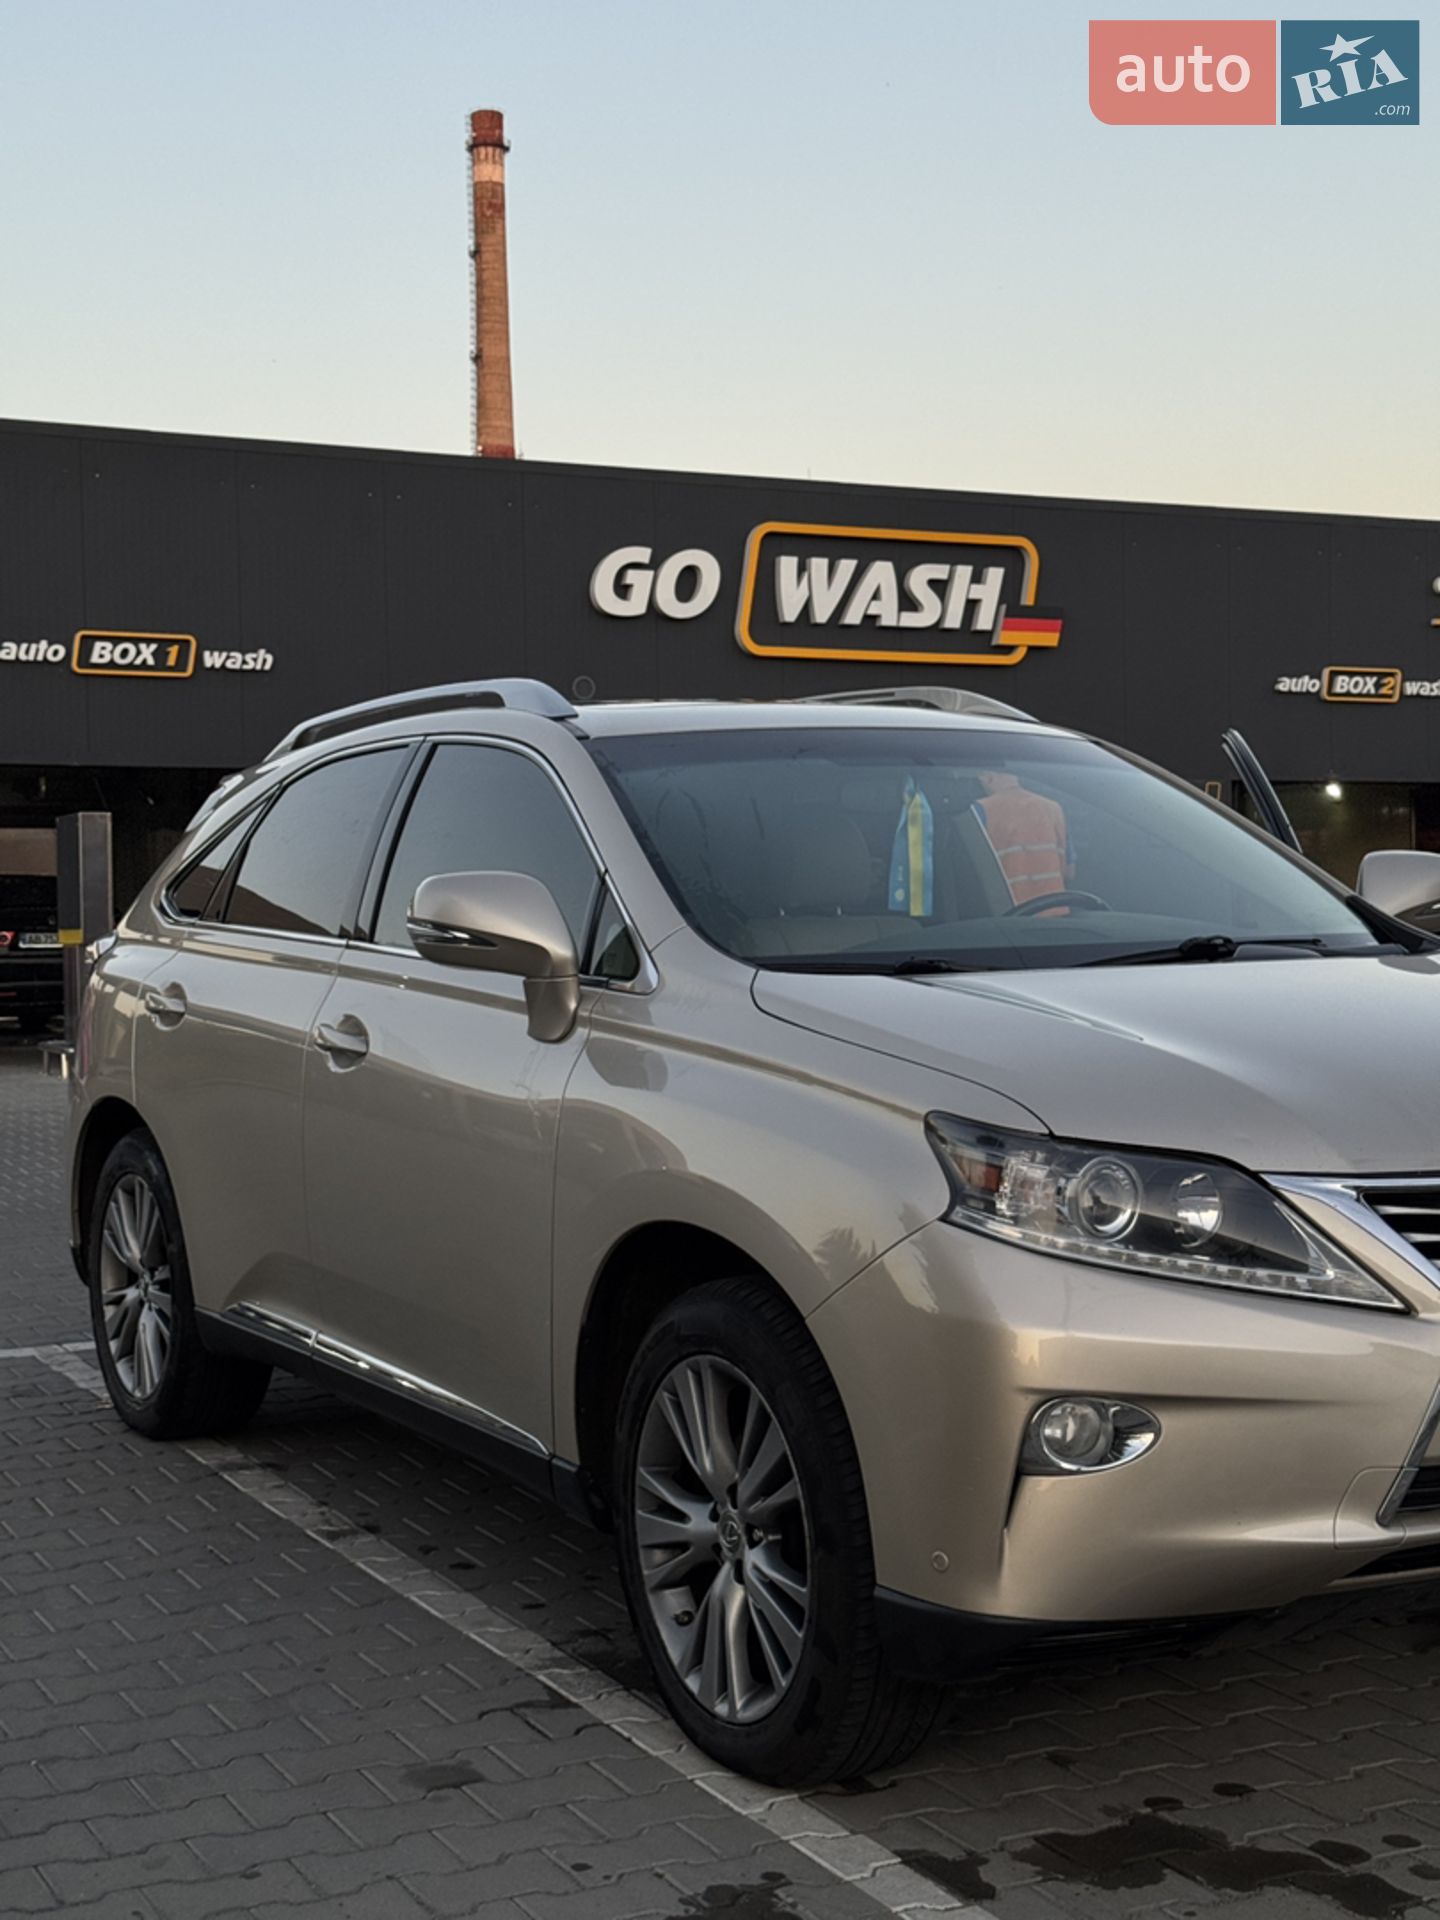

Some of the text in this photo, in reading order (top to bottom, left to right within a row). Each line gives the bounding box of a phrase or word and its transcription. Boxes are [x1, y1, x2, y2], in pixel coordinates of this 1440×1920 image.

[589, 545, 1006, 632] GO WASH
[0, 639, 275, 671] auto BOX 1 wash
[1275, 674, 1321, 693] auto
[1333, 675, 1378, 695] BOX
[1380, 677, 1395, 695] 2
